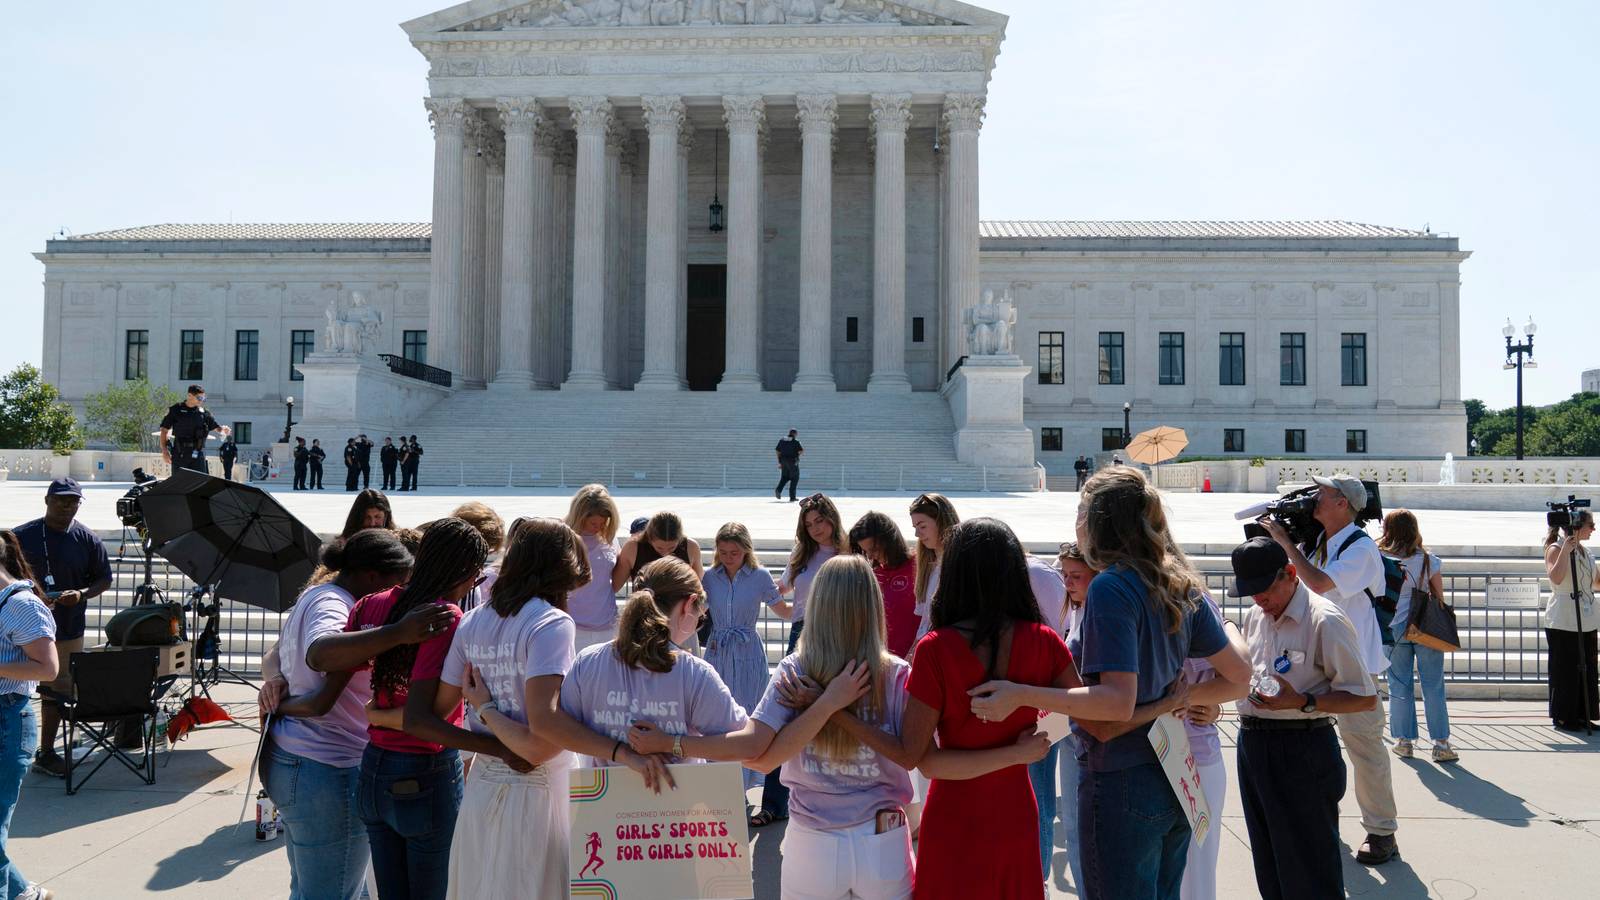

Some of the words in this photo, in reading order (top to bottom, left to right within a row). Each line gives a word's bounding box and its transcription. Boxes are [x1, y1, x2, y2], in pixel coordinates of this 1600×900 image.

[606, 690, 640, 714] GIRS
[641, 701, 679, 717] JUST
[820, 761, 881, 778] SPORTS
[615, 811, 658, 820] CONCERNED
[660, 809, 686, 818] WOMEN
[687, 809, 700, 817] FOR
[702, 808, 733, 817] AMERICA
[669, 821, 728, 838] SPORTS
[616, 844, 644, 861] FOR
[649, 843, 694, 860] GIRLS
[698, 842, 743, 859] ONLY.
